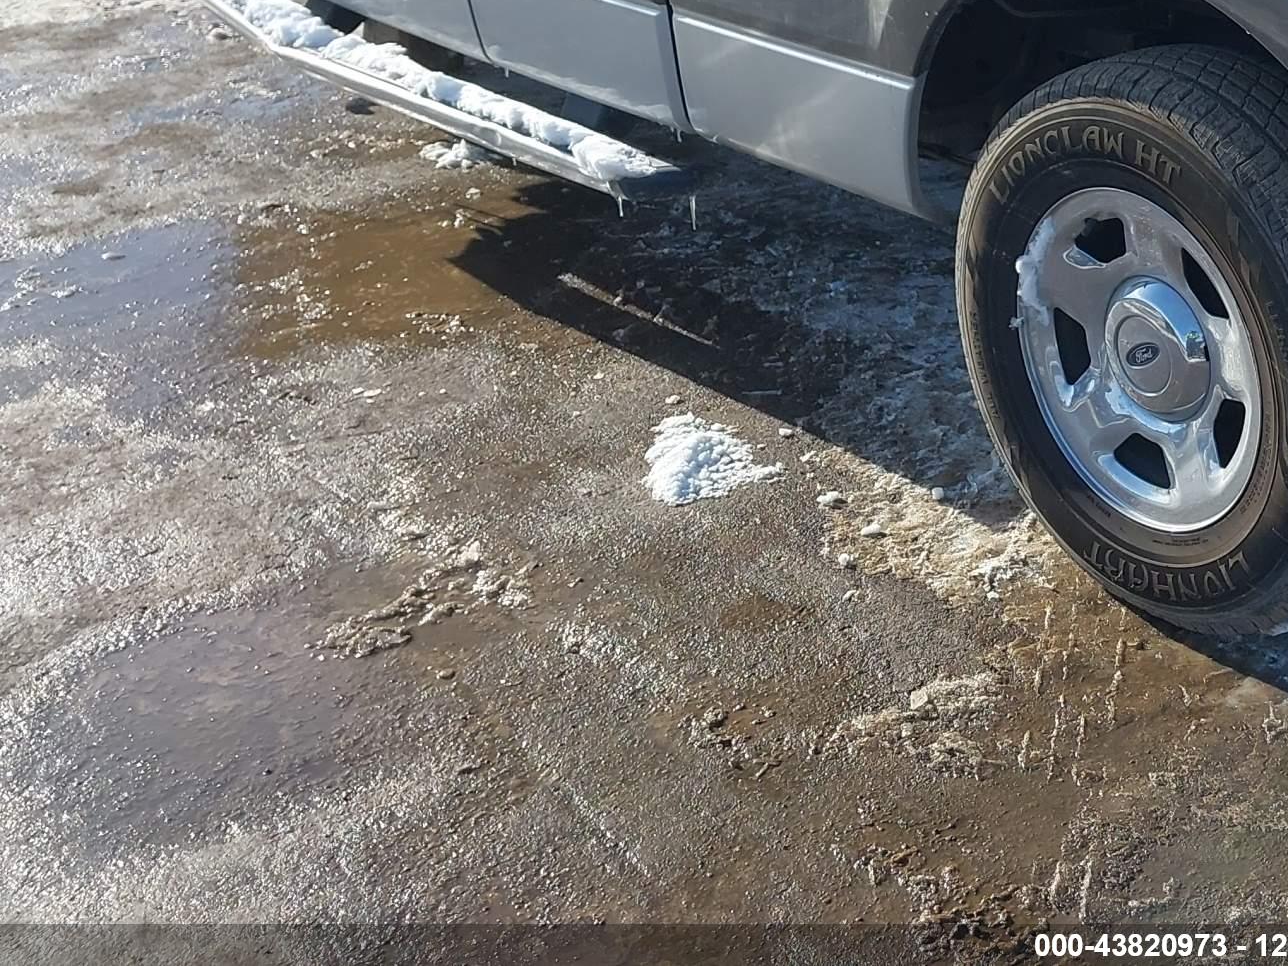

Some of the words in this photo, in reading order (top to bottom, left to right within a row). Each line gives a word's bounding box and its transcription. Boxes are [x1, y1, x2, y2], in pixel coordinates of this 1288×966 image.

[989, 125, 1124, 205] LIONCLAW
[1133, 139, 1182, 186] HT
[1135, 347, 1153, 363] Ford
[1083, 540, 1250, 602] LIONHART
